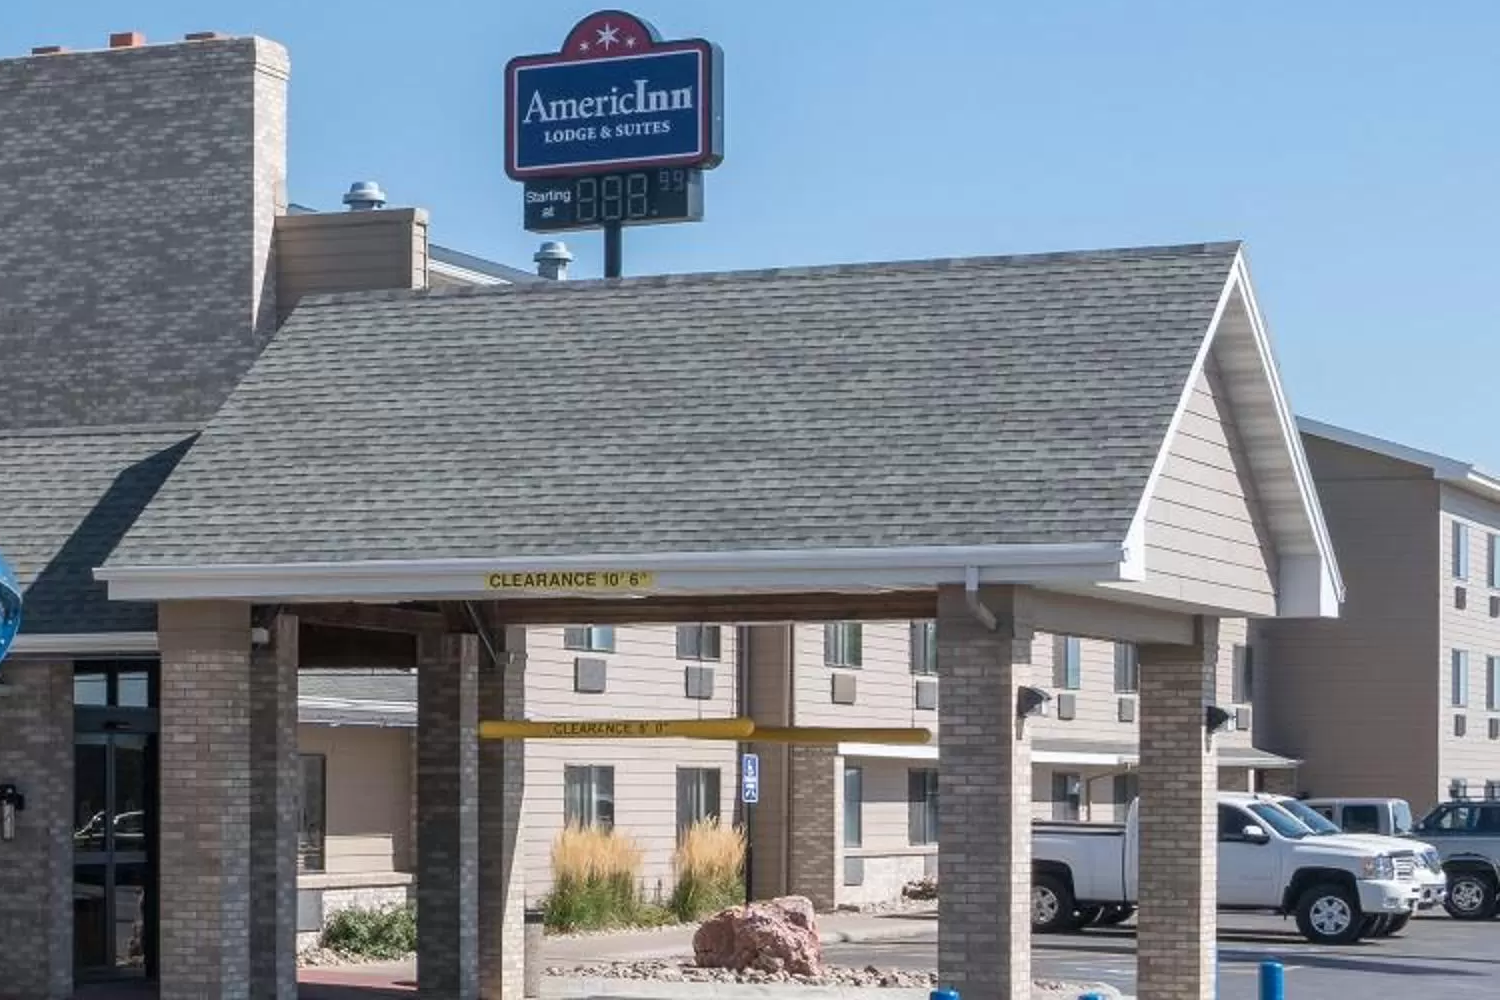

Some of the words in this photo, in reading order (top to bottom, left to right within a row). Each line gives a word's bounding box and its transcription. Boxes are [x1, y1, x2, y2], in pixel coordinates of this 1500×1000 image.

[522, 79, 693, 124] AmericInn
[544, 127, 597, 144] LODGE
[600, 126, 612, 139] &
[615, 120, 671, 137] SUITES
[526, 189, 572, 203] Starting
[541, 206, 556, 218] at
[489, 571, 597, 588] CLEARANCE
[602, 571, 624, 587] 10'
[555, 722, 635, 735] CLEARANCE
